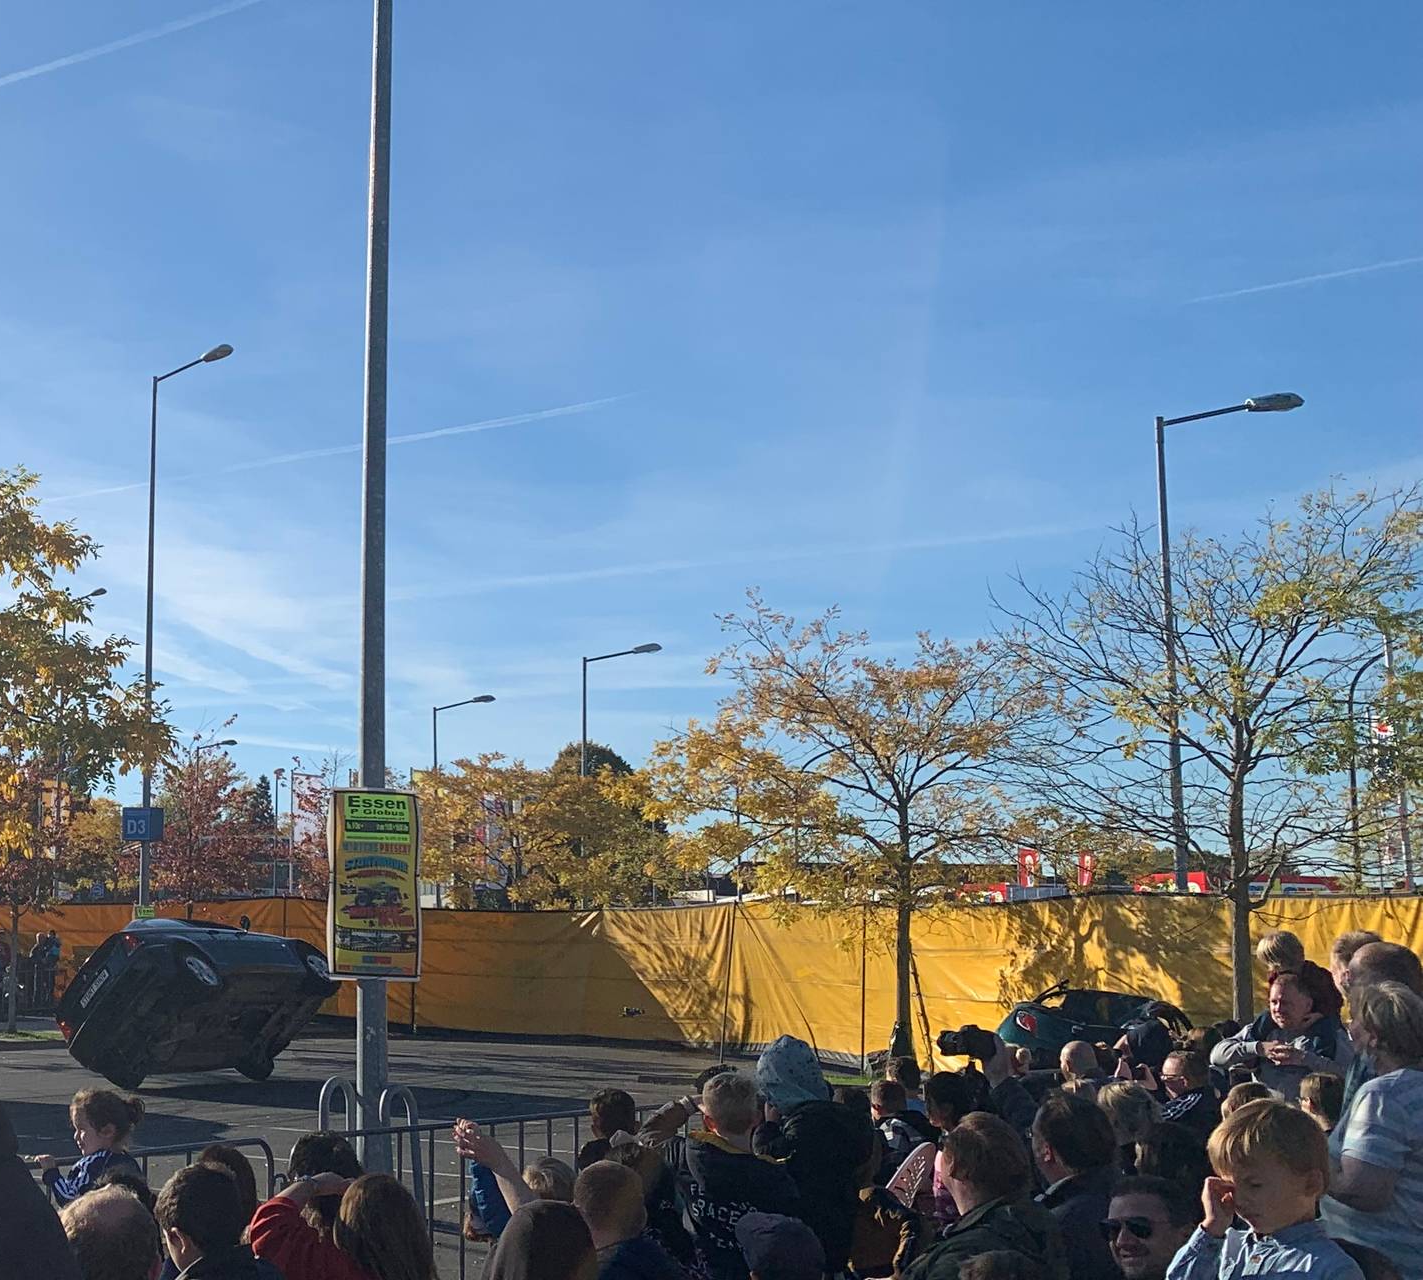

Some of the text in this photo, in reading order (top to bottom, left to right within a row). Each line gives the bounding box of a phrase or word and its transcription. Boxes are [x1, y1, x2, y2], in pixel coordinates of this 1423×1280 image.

[347, 795, 407, 810] Essen
[363, 808, 405, 816] Globus
[127, 819, 146, 834] D3
